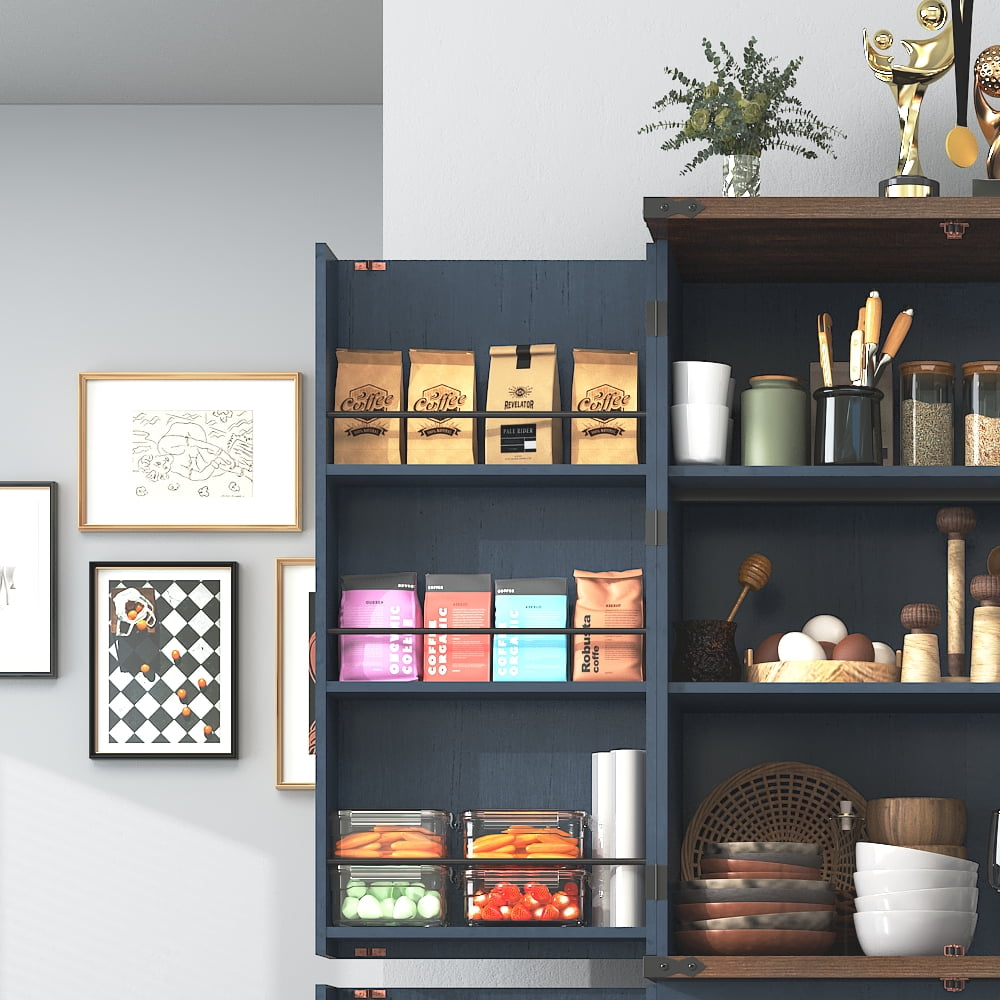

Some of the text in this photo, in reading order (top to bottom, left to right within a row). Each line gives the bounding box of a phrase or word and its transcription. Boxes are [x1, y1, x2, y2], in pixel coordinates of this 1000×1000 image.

[341, 391, 394, 412] Coffee
[413, 391, 467, 412] Coffee
[504, 400, 534, 410] REVELATOR
[577, 391, 631, 412] Coffee
[428, 620, 436, 676] COFFE
[497, 621, 507, 677] COFFE
[592, 645, 600, 674] coffe
